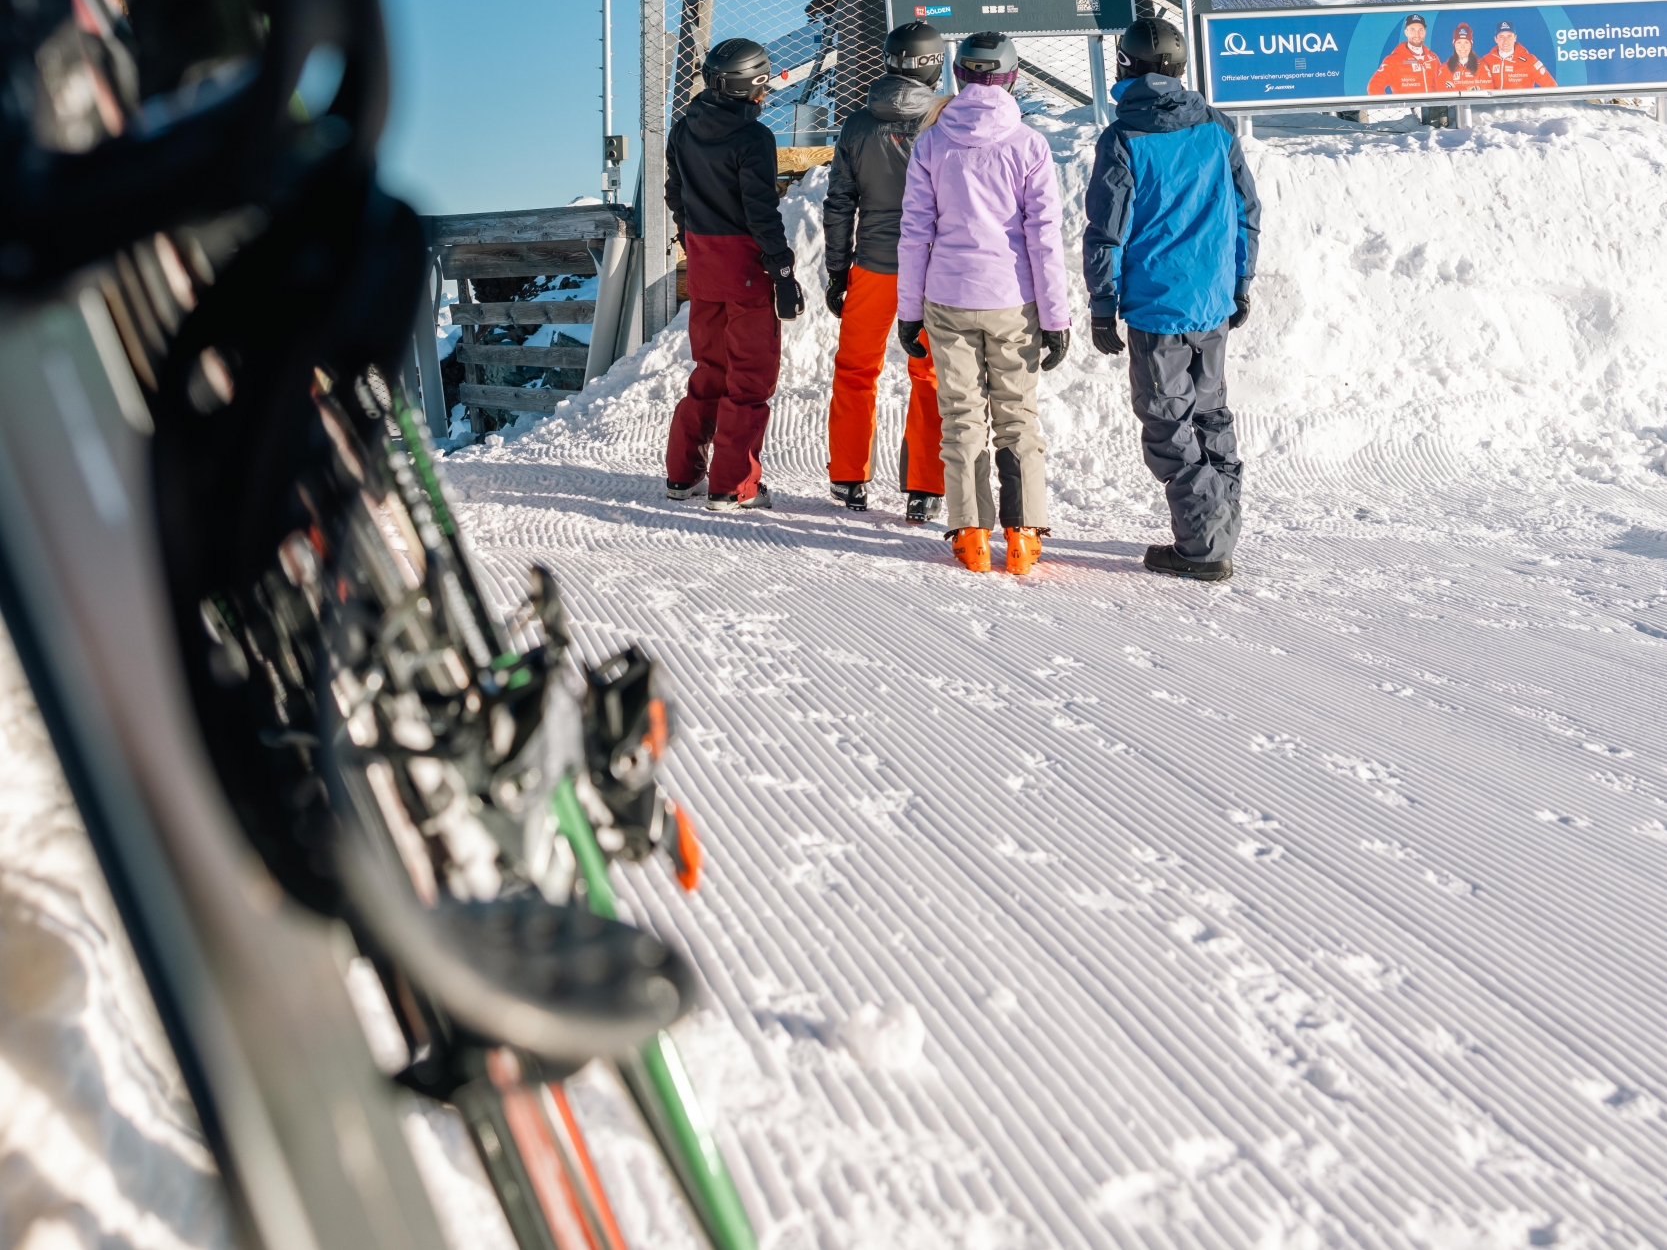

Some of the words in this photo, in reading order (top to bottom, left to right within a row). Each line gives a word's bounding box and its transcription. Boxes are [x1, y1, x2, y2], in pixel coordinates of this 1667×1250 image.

[926, 6, 951, 16] SÖLDEN
[1260, 33, 1338, 54] UNIQA
[1556, 24, 1659, 44] gemeinsam
[1558, 46, 1615, 61] besser
[1620, 43, 1667, 58] leben
